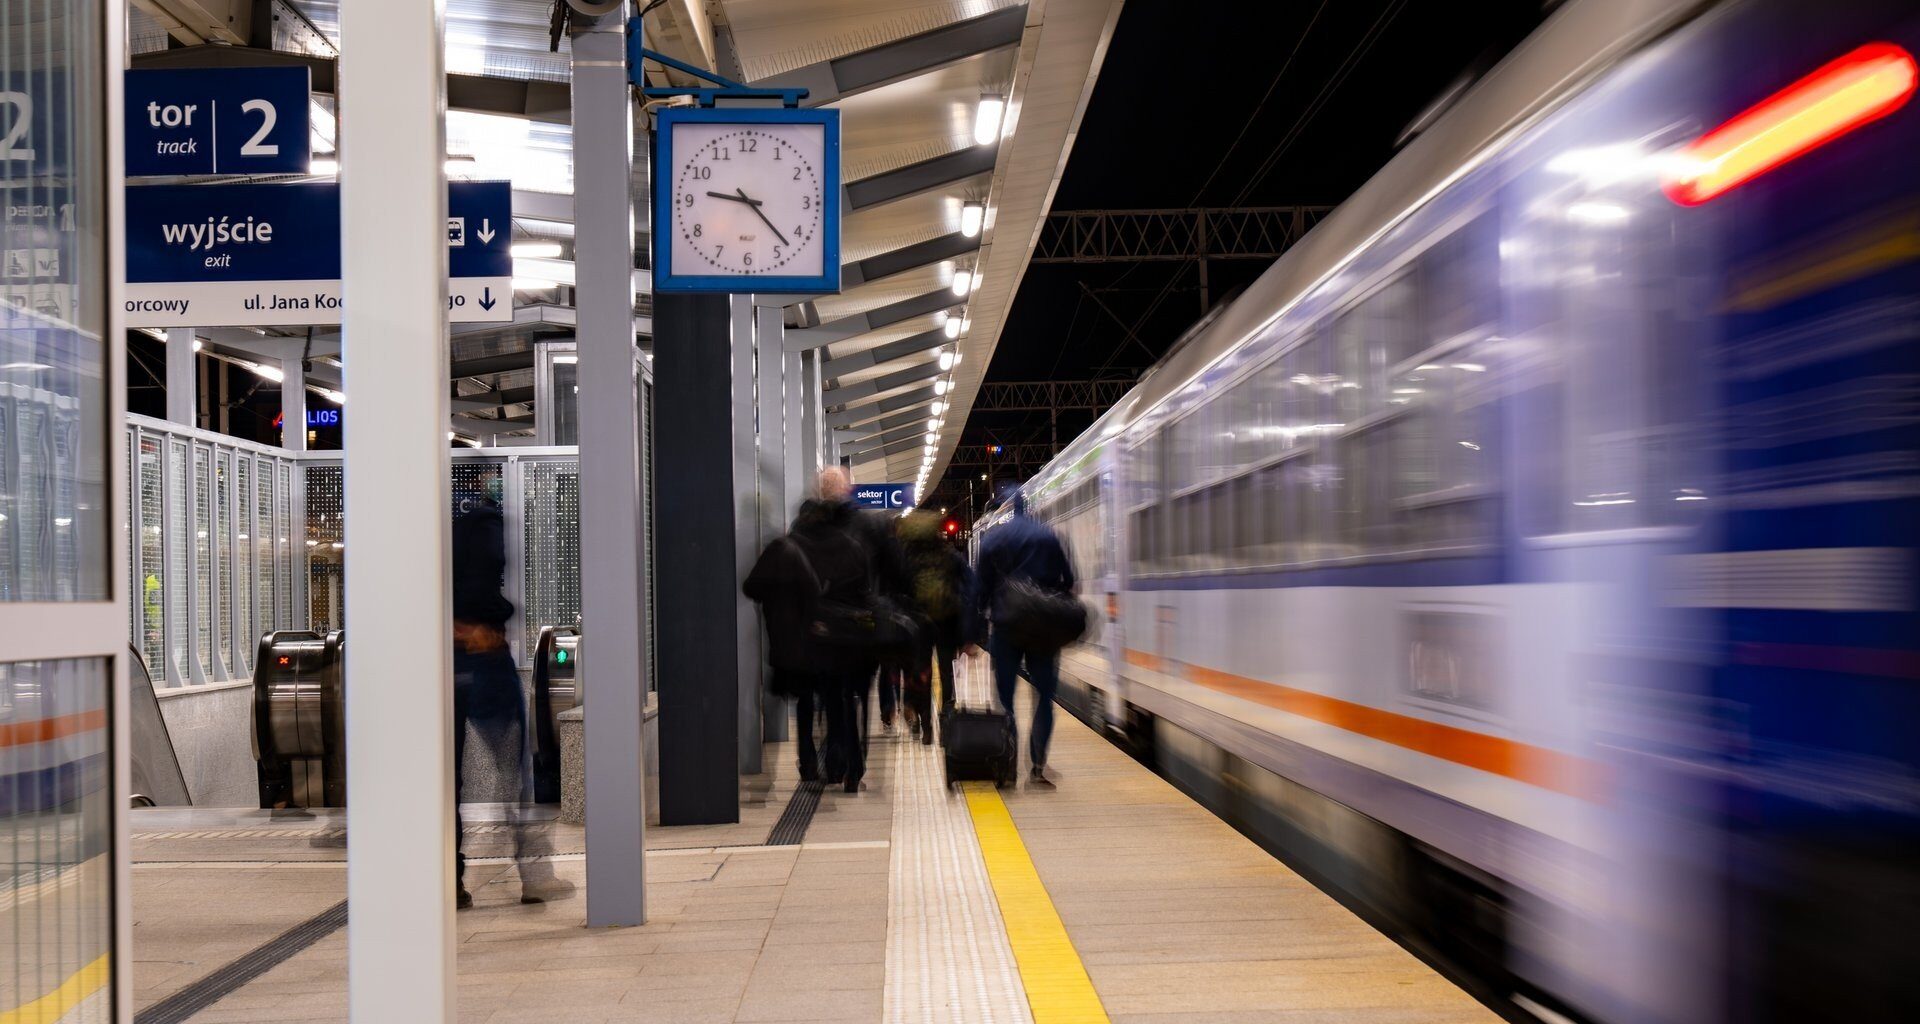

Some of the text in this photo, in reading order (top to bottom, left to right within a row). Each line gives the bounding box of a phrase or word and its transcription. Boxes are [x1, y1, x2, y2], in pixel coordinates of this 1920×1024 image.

[147, 100, 197, 127] tor
[240, 98, 279, 156] 2
[156, 137, 197, 154] track
[738, 139, 757, 152] 12
[711, 147, 731, 161] 11
[773, 147, 782, 160] 1
[692, 166, 711, 180] 10
[793, 167, 801, 180] 2
[685, 194, 694, 207] 9
[802, 196, 811, 210] 3
[162, 216, 273, 250] wyjście
[693, 223, 702, 237] 8
[793, 224, 802, 238] 4
[715, 245, 724, 258] 7
[743, 252, 752, 265] 6
[773, 245, 781, 259] 5
[204, 253, 232, 268] exit
[125, 299, 190, 315] orcowy
[244, 293, 343, 310] ul. Jana Ko
[307, 410, 338, 423] LIOS
[858, 490, 882, 498] sektor
[891, 490, 902, 505] C
